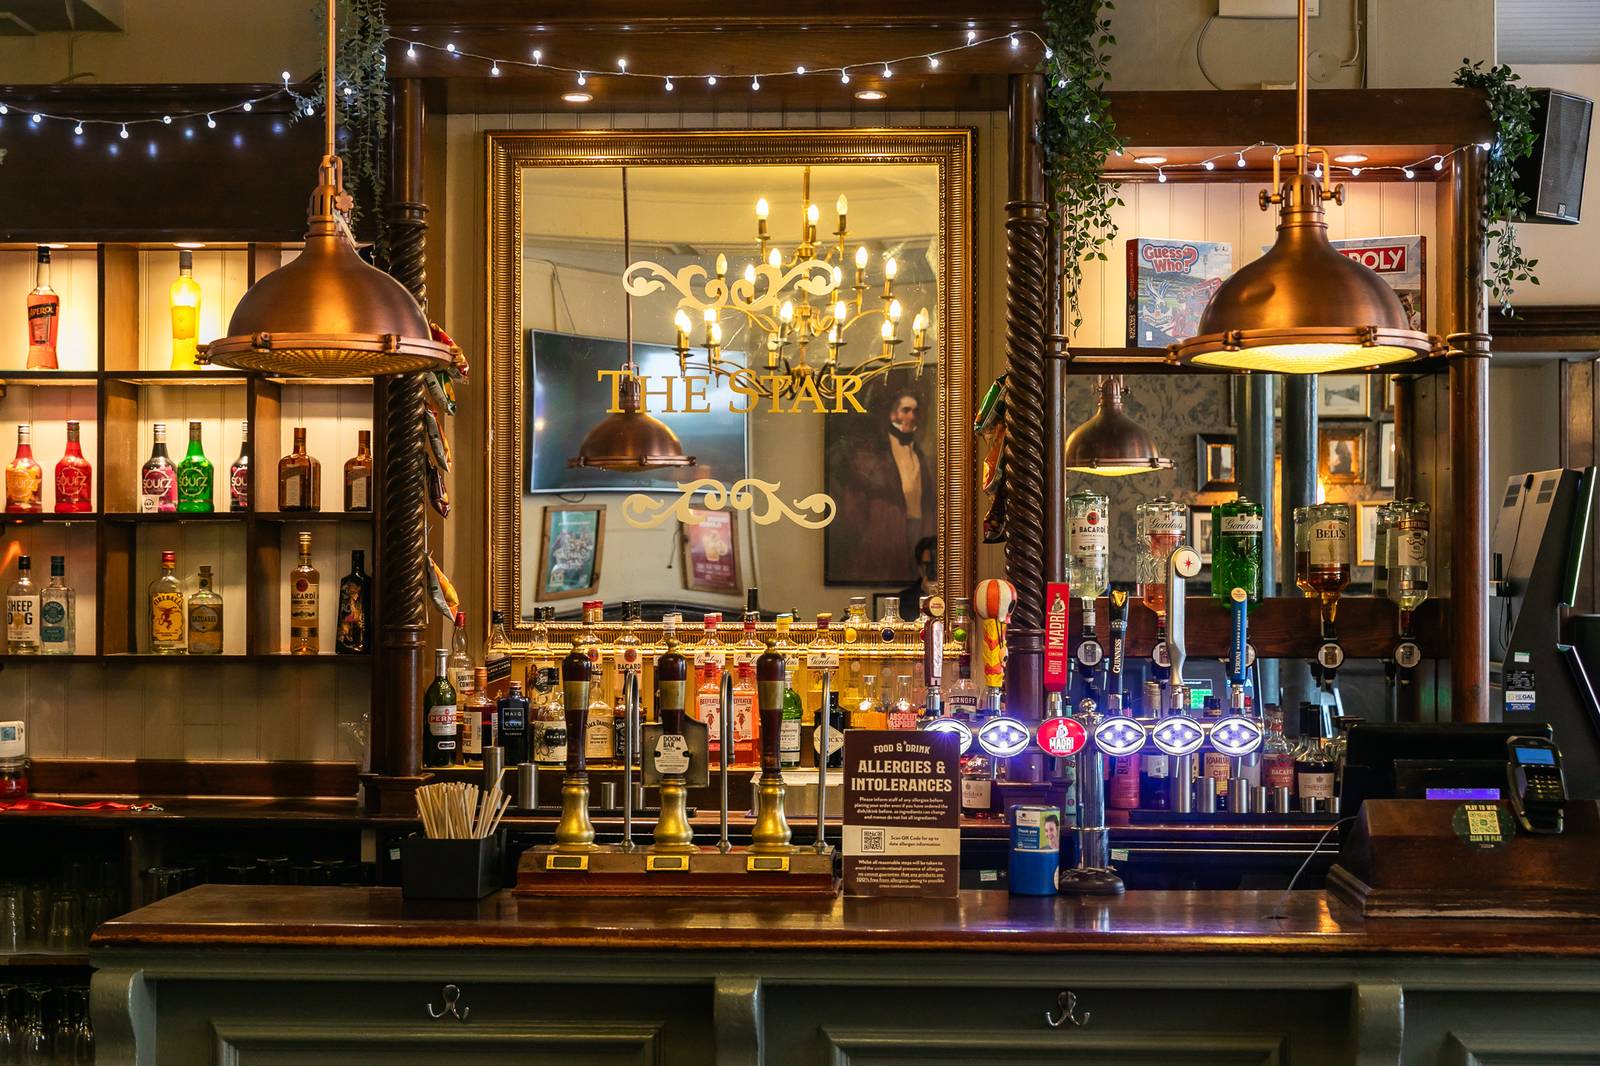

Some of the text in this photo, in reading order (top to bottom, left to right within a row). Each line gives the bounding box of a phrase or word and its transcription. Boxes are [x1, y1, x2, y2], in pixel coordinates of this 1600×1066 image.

[1142, 245, 1182, 261] Guess
[598, 369, 867, 414] THE STAR
[232, 476, 248, 487] sou
[1315, 528, 1346, 540] BELL'S
[8, 600, 33, 612] SHEEP
[1112, 638, 1123, 674] GUINNESS
[874, 742, 931, 754] FOOD & DRINK
[858, 760, 946, 774] ALLERGIES &
[851, 778, 953, 792] INTOLERANCES
